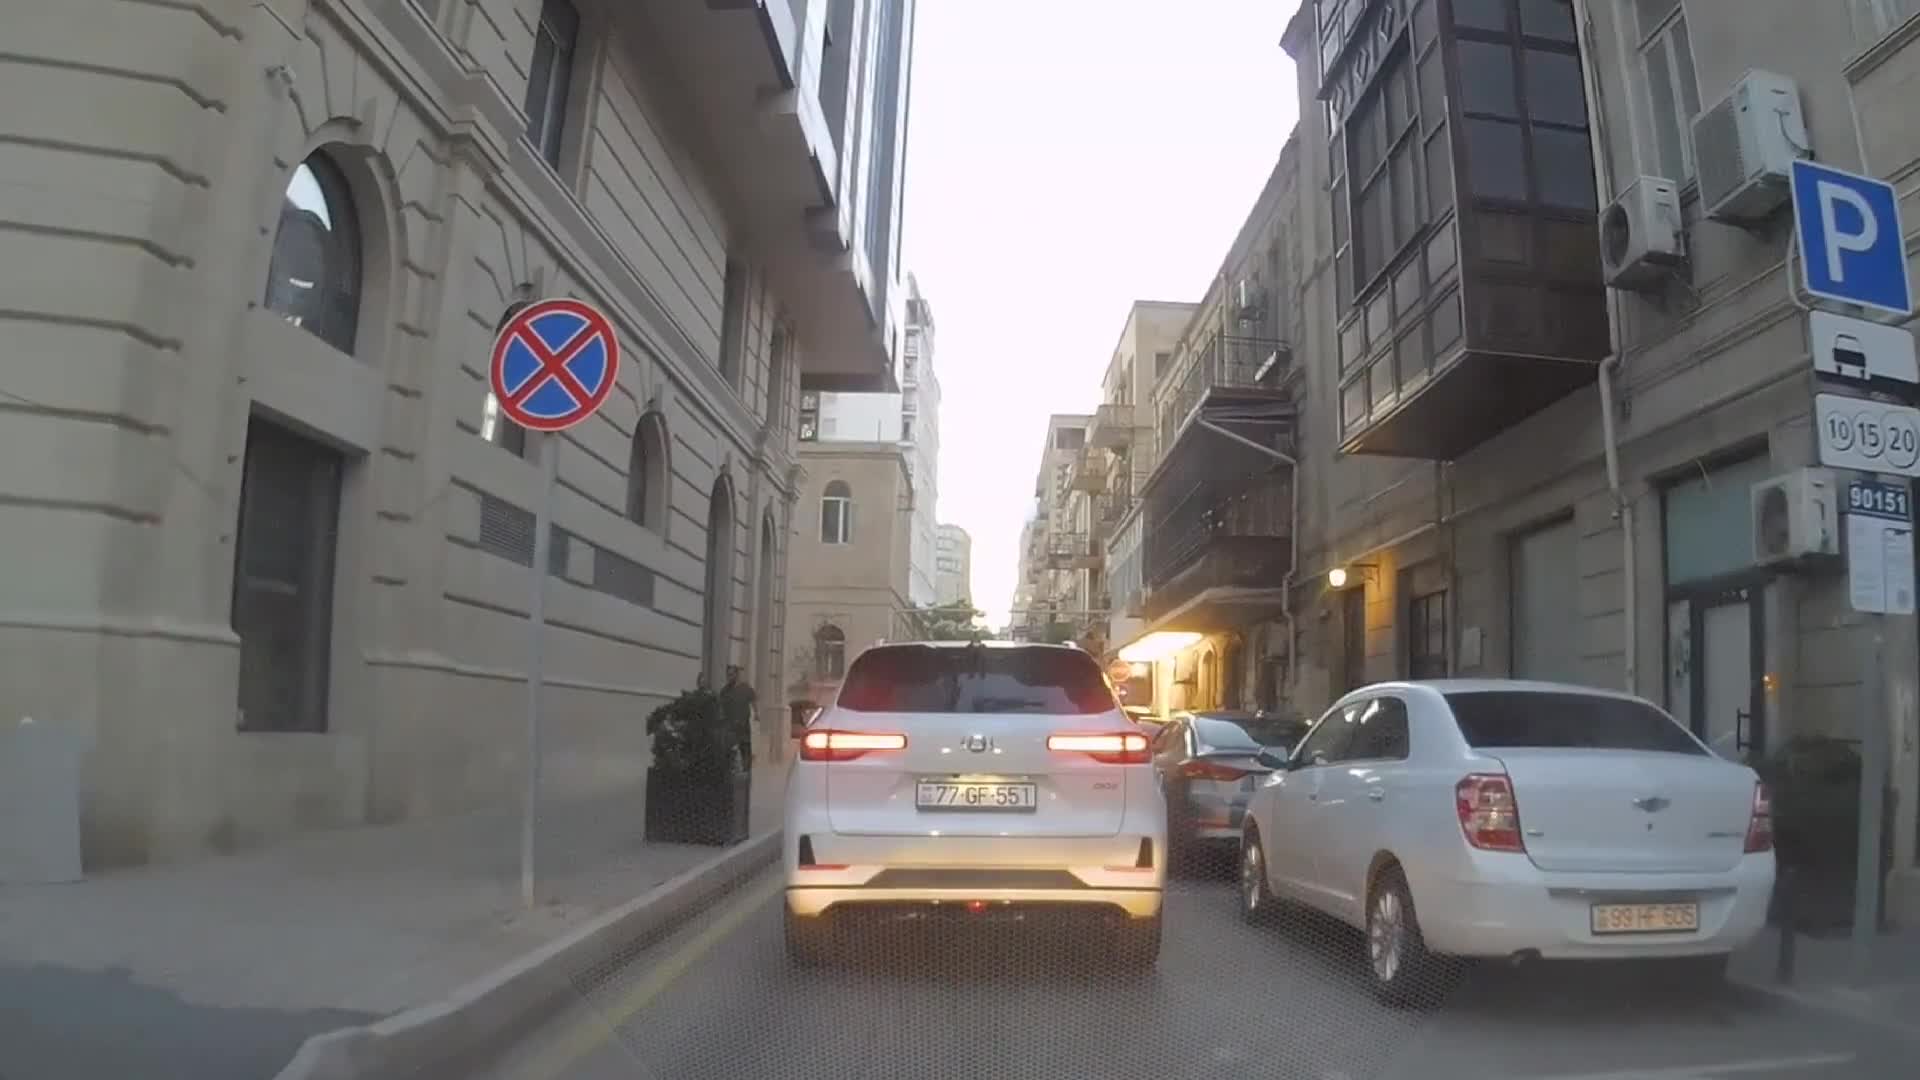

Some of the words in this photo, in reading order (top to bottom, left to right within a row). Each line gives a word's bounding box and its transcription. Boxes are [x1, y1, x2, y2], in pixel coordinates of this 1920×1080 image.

[1817, 180, 1878, 283] P
[1828, 418, 1849, 440] 10
[1858, 422, 1880, 447] 15
[1889, 426, 1915, 453] 20
[1851, 487, 1906, 514] 90151
